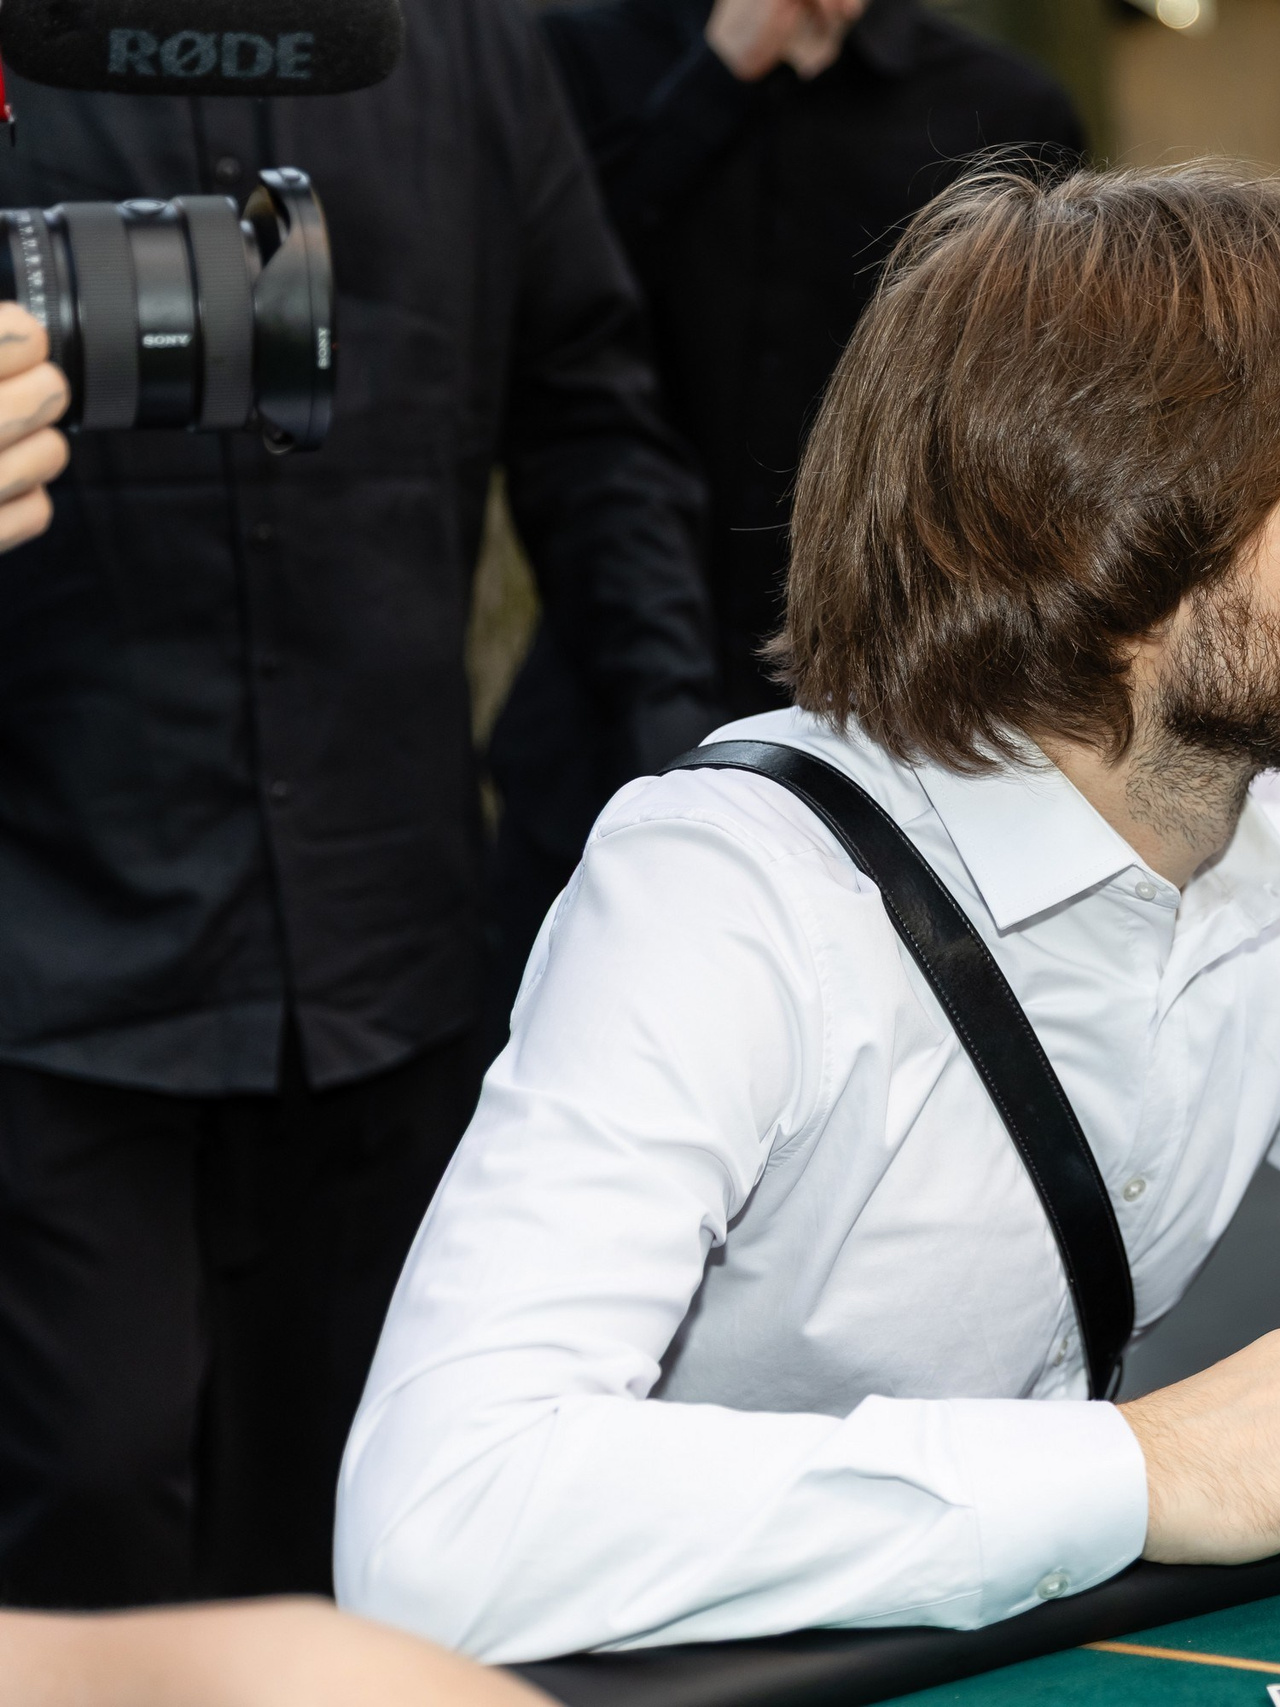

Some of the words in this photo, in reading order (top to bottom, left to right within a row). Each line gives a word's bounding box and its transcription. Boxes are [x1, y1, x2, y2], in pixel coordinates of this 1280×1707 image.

[108, 28, 314, 79] RØDE
[142, 333, 191, 348] SONY
[317, 327, 331, 369] SONY
